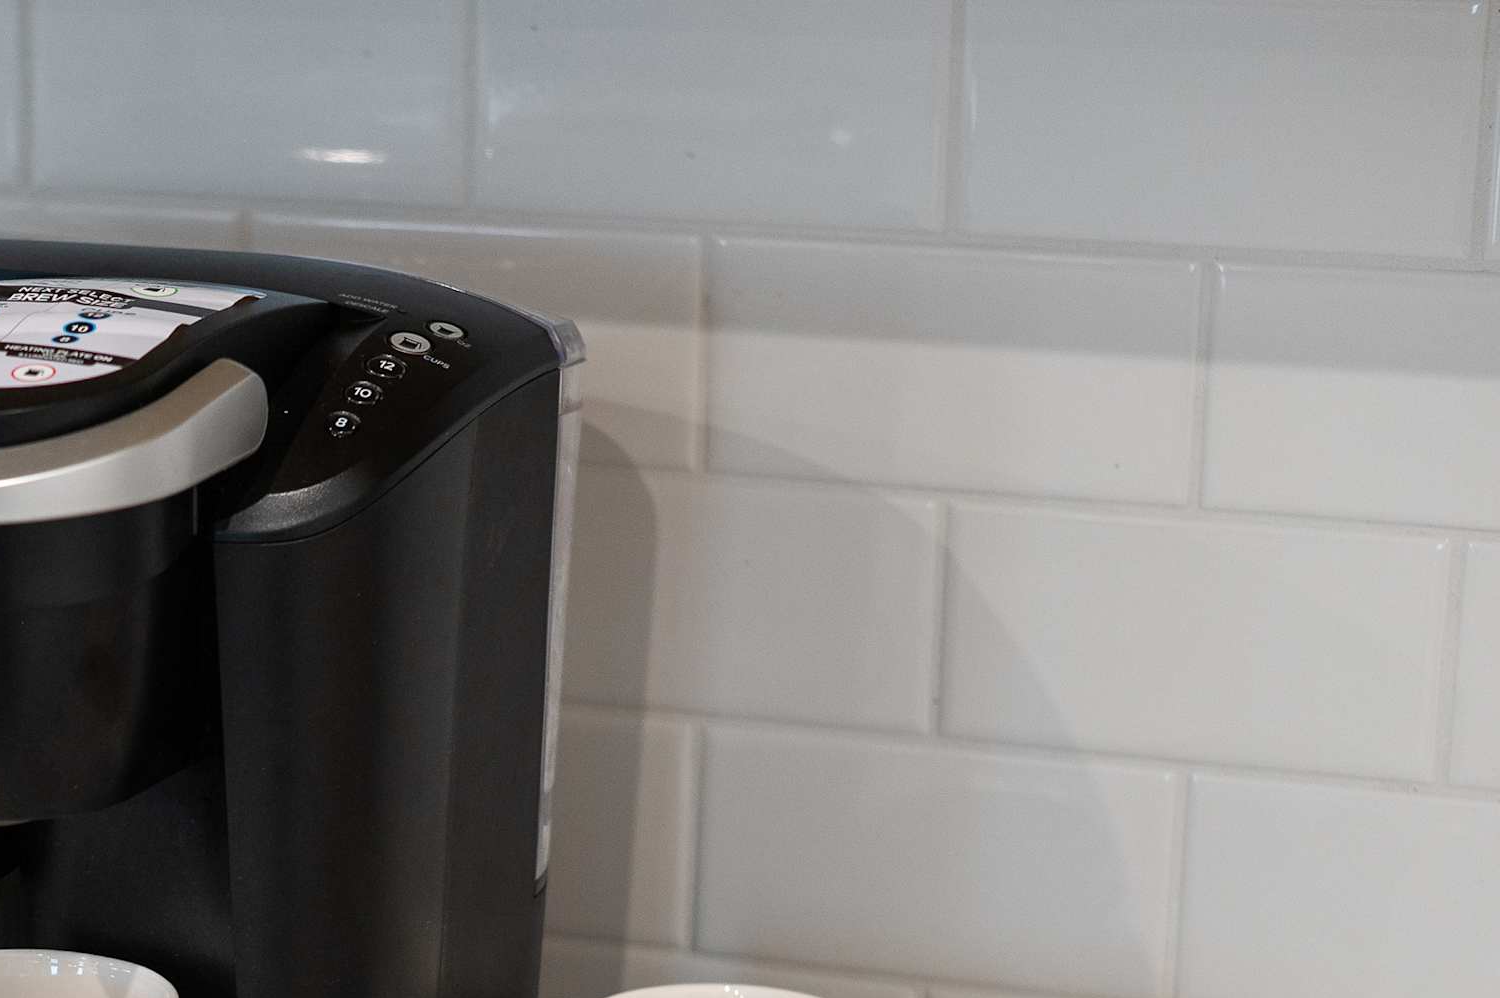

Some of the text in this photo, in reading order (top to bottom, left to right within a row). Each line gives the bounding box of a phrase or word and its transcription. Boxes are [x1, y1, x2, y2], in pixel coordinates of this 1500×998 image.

[7, 293, 129, 309] BREW SIZE
[66, 288, 135, 304] SELECT
[70, 323, 89, 333] 10
[379, 360, 396, 371] 12
[423, 354, 451, 369] CUPS
[354, 387, 372, 399] 10
[335, 417, 348, 428] 8
